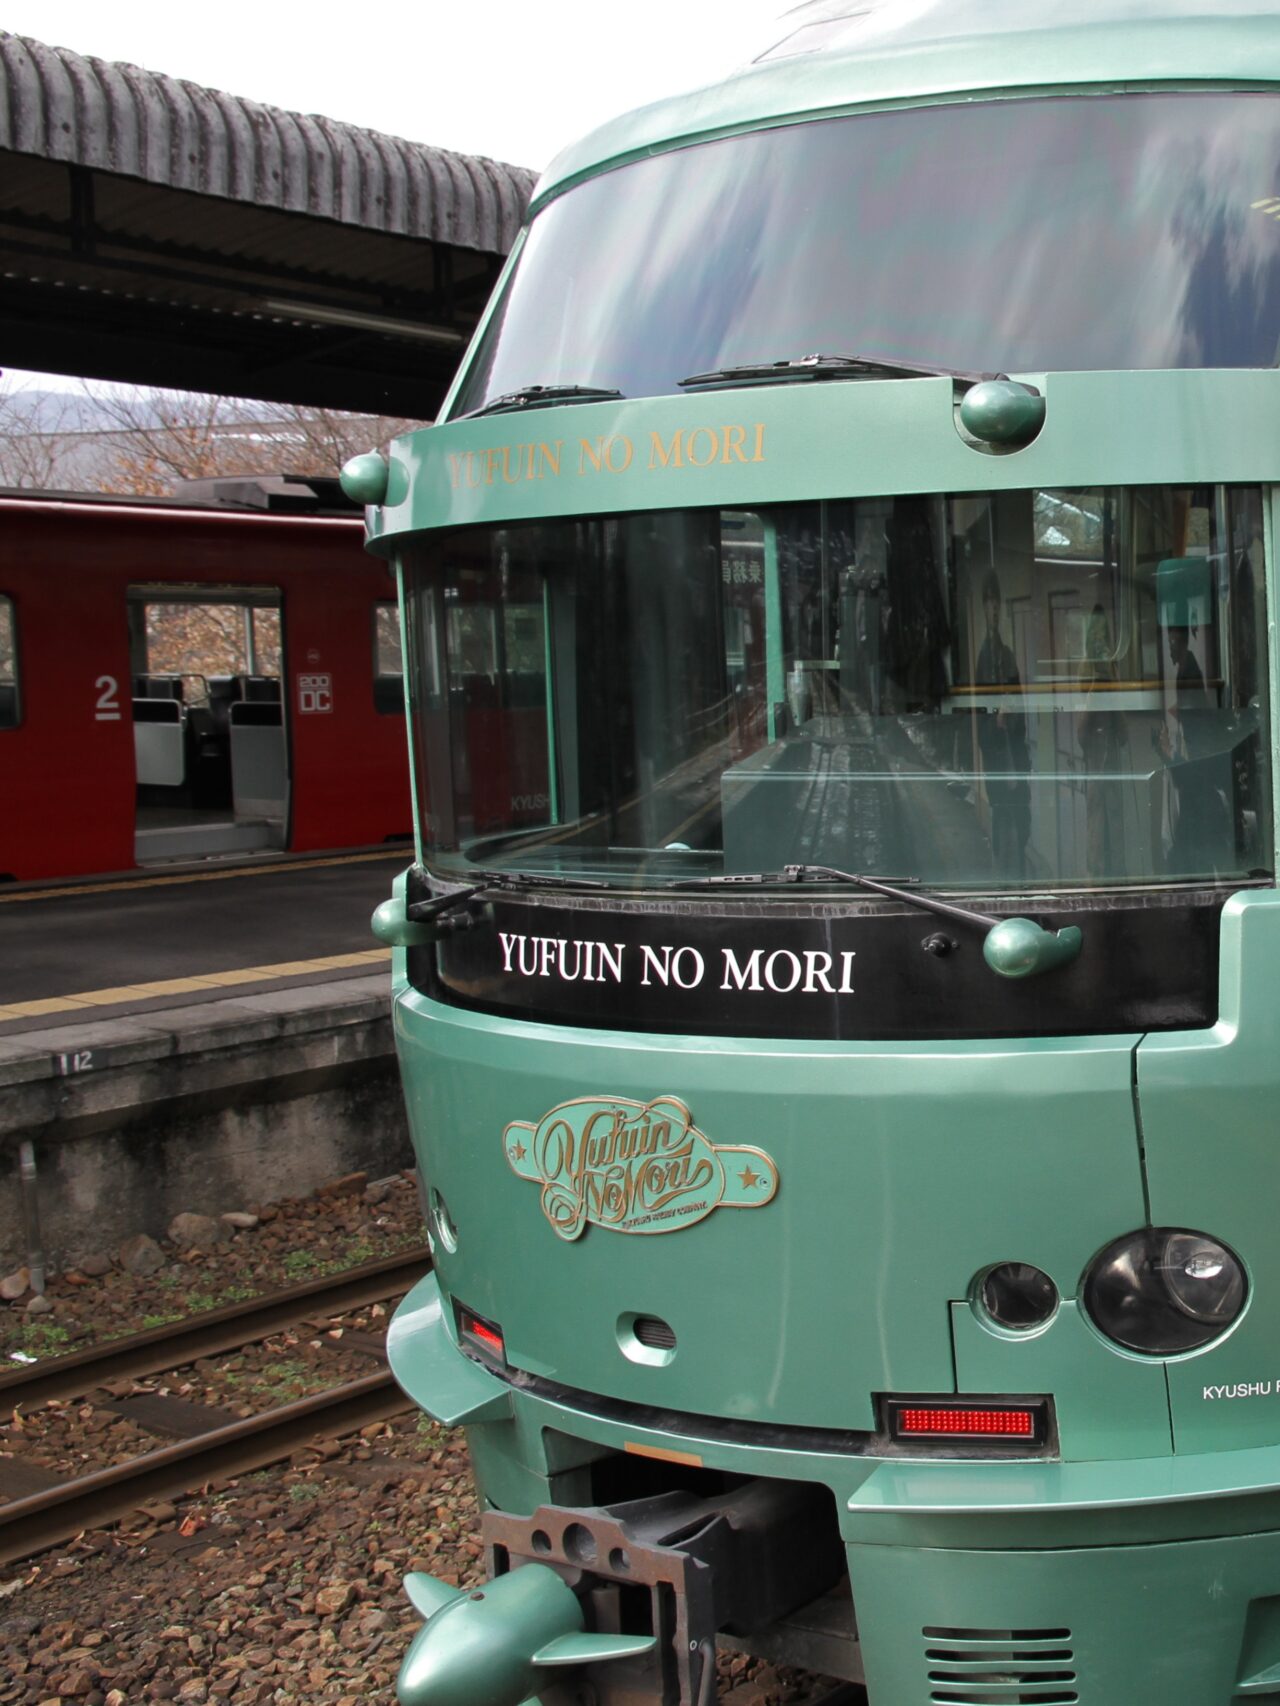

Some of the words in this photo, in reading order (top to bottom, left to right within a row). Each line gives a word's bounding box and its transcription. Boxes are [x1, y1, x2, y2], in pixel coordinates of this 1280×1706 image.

[449, 439, 565, 489] YUFUIN
[577, 434, 634, 476] NO
[648, 423, 767, 469] MORI
[95, 674, 119, 708] 2
[299, 676, 329, 687] 200
[300, 690, 331, 711] DC
[498, 932, 626, 983] YUFUIN
[640, 945, 705, 989] NO
[719, 948, 856, 993] MORI
[543, 1109, 690, 1190] Yufuin
[625, 1138, 713, 1212] Mori
[1202, 1380, 1272, 1400] KYUSHU
